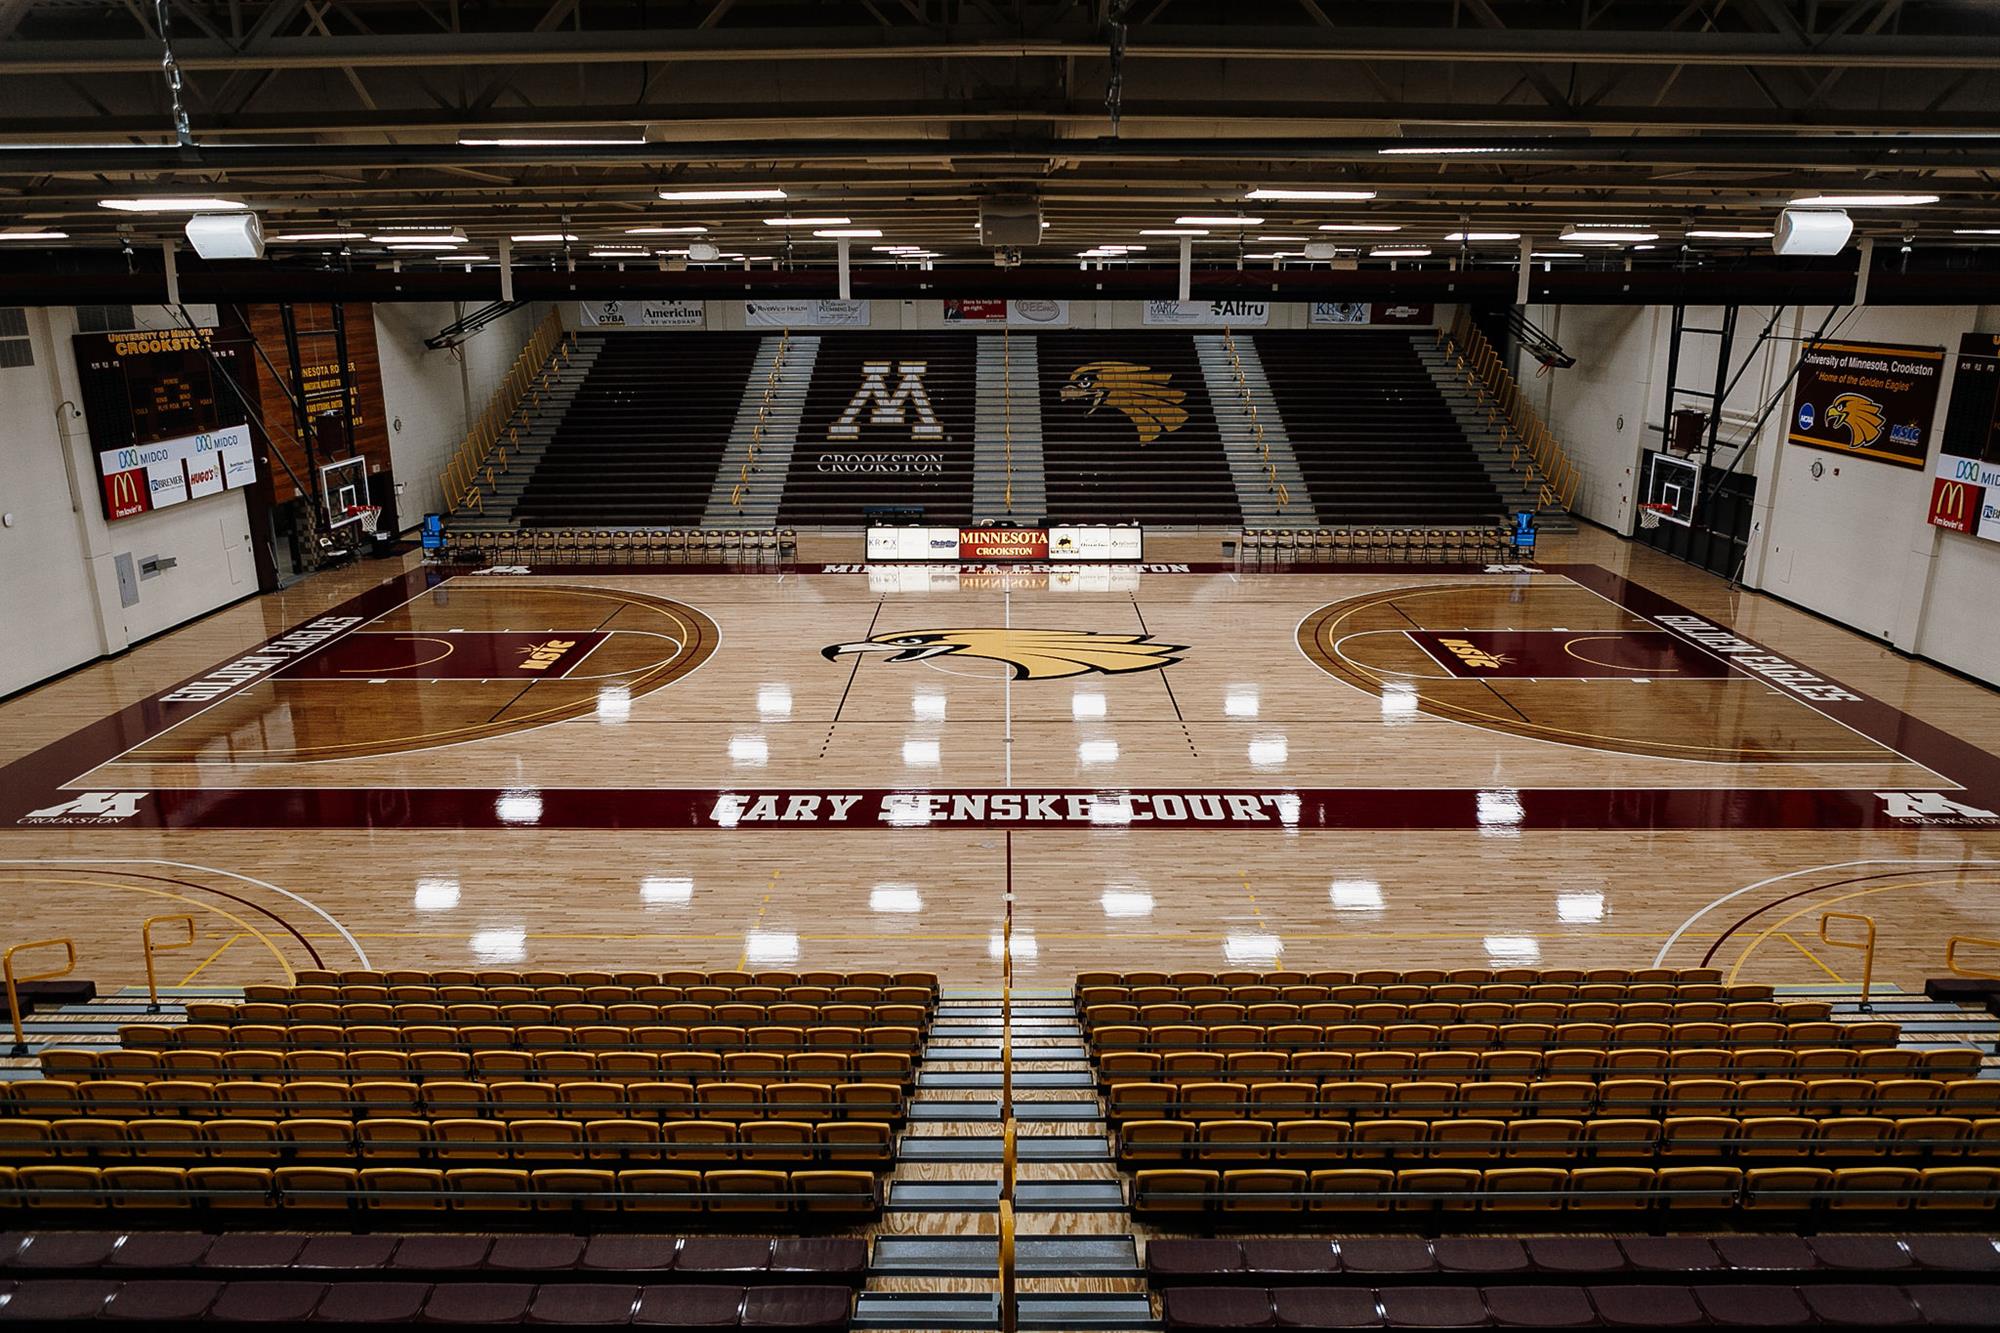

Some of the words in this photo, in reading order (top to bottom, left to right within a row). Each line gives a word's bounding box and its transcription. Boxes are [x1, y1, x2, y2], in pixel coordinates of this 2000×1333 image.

[599, 315, 625, 323] CYBA
[1890, 361, 1934, 376] Crookston
[826, 361, 944, 440] M
[214, 435, 238, 448] MIDCO
[140, 449, 168, 464] MIDCO
[817, 454, 944, 472] CROOKSTON
[158, 475, 183, 488] BREMER
[191, 468, 213, 485] HUGO'S
[960, 532, 1048, 544] MINNESOTA
[976, 547, 1033, 556] CROOKSTON
[158, 656, 290, 702] GOLDEN
[255, 616, 364, 654] EAGLES
[1654, 615, 1765, 653] GOLDEN
[1730, 655, 1864, 702] EAGLES
[709, 795, 862, 821] GARY
[1117, 795, 1300, 821] COURT
